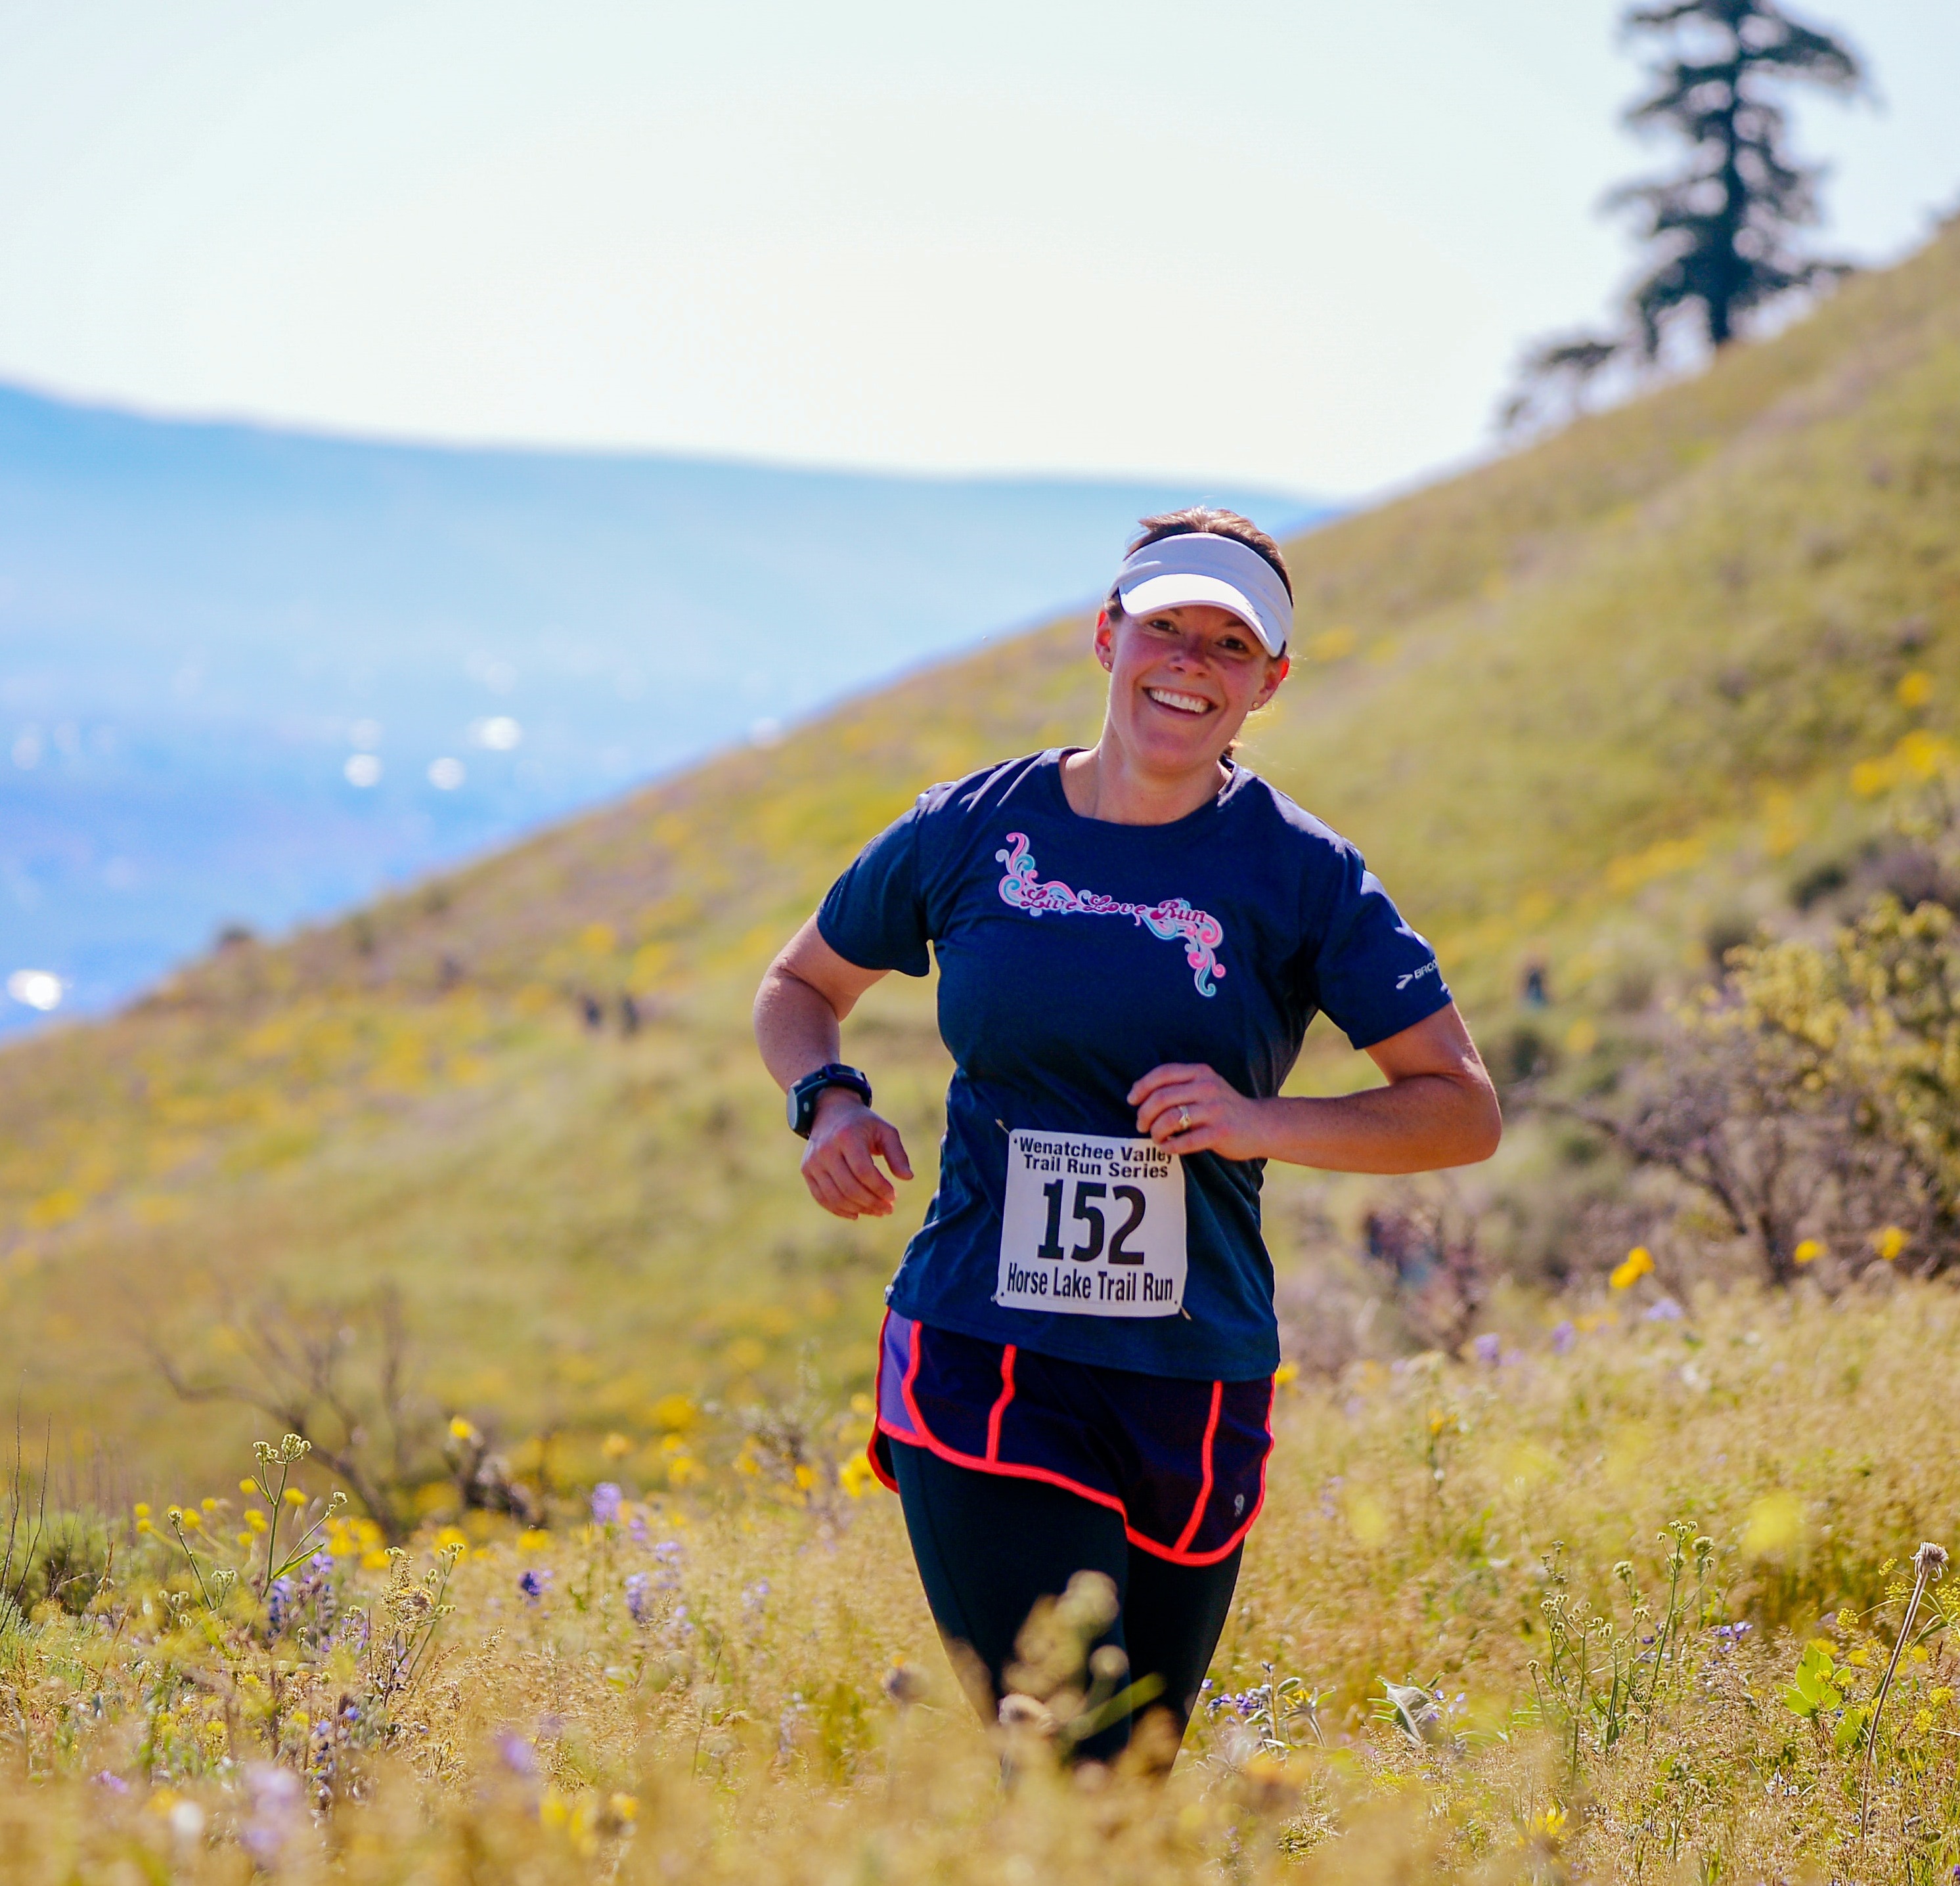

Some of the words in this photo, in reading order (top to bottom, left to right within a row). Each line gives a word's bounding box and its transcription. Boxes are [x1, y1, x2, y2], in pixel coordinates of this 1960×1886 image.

[1021, 888, 1077, 909] Live
[1083, 895, 1147, 913] Love
[1150, 900, 1205, 923] Run
[1019, 1136, 1114, 1160] Wenatchee
[1023, 1154, 1061, 1172] Trail
[1067, 1160, 1102, 1175] Run
[1108, 1162, 1169, 1178] Series
[1037, 1179, 1146, 1265] 152
[1007, 1262, 1048, 1295] Horse
[1053, 1267, 1092, 1300] Lake
[1098, 1271, 1136, 1301] Trail
[1143, 1272, 1173, 1302] Run
